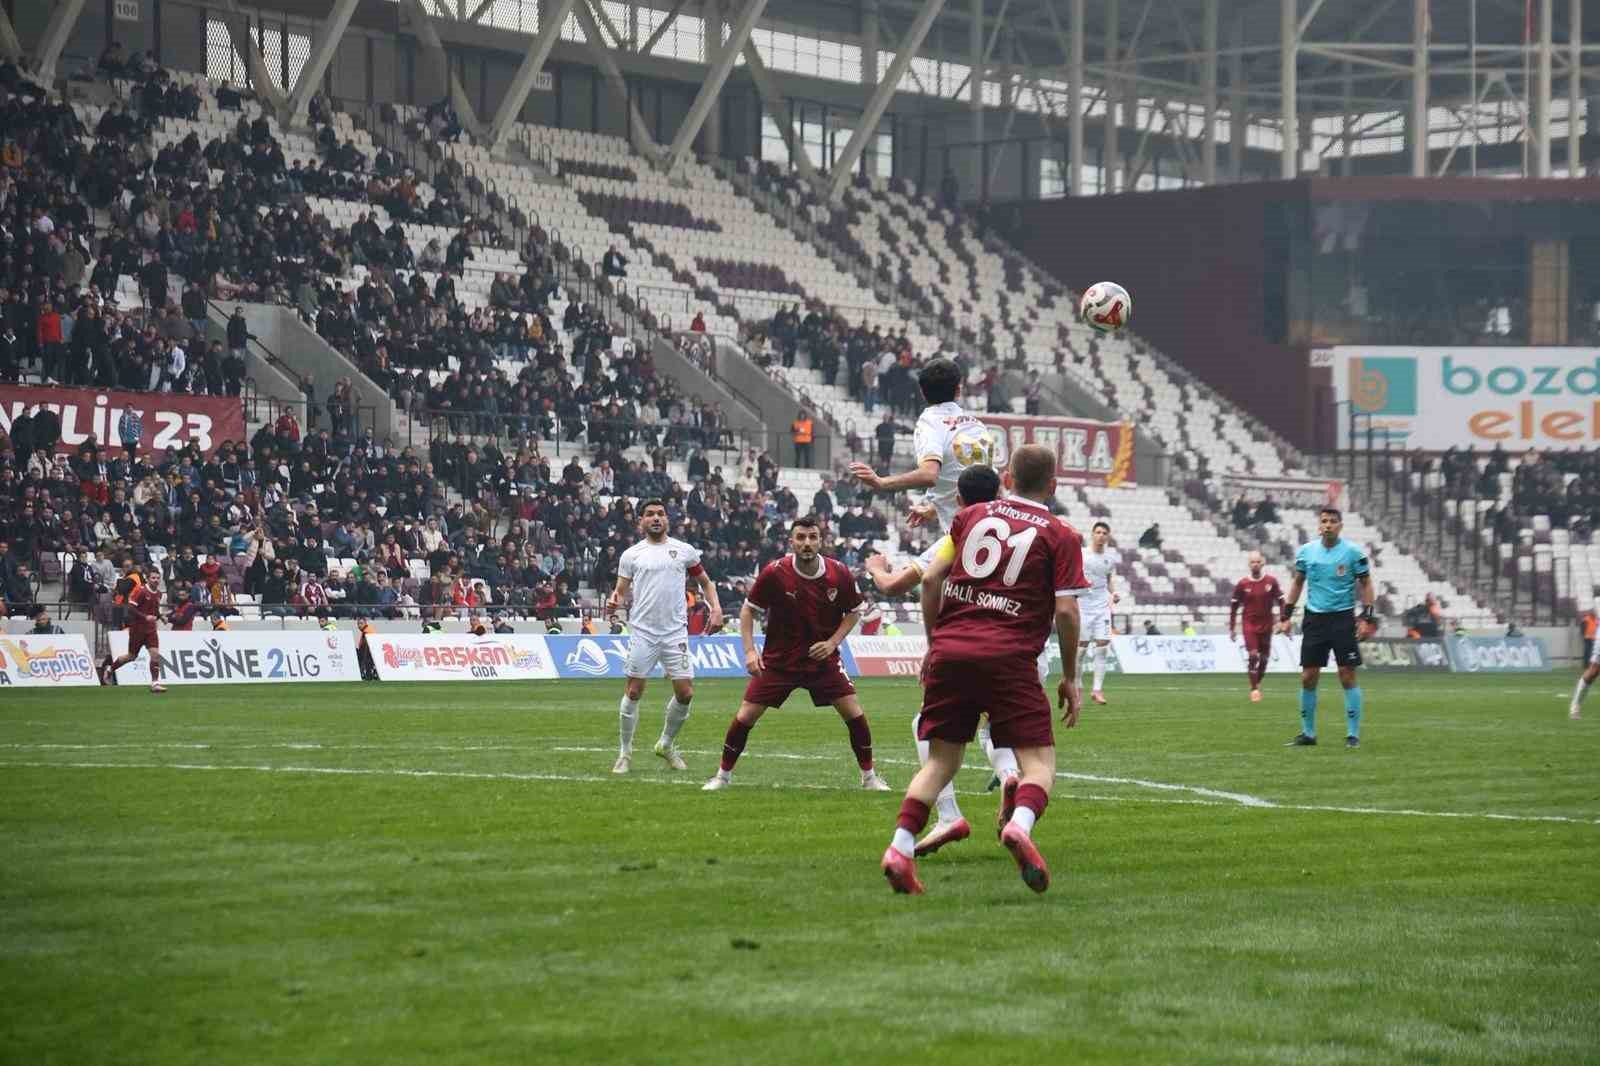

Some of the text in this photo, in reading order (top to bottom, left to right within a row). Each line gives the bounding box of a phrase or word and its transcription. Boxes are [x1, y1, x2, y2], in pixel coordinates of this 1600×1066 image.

[153, 411, 212, 451] 23
[1468, 400, 1600, 441] ele
[961, 516, 1037, 587] 61
[943, 580, 974, 604] HALİL
[471, 665, 499, 679] GIDA
